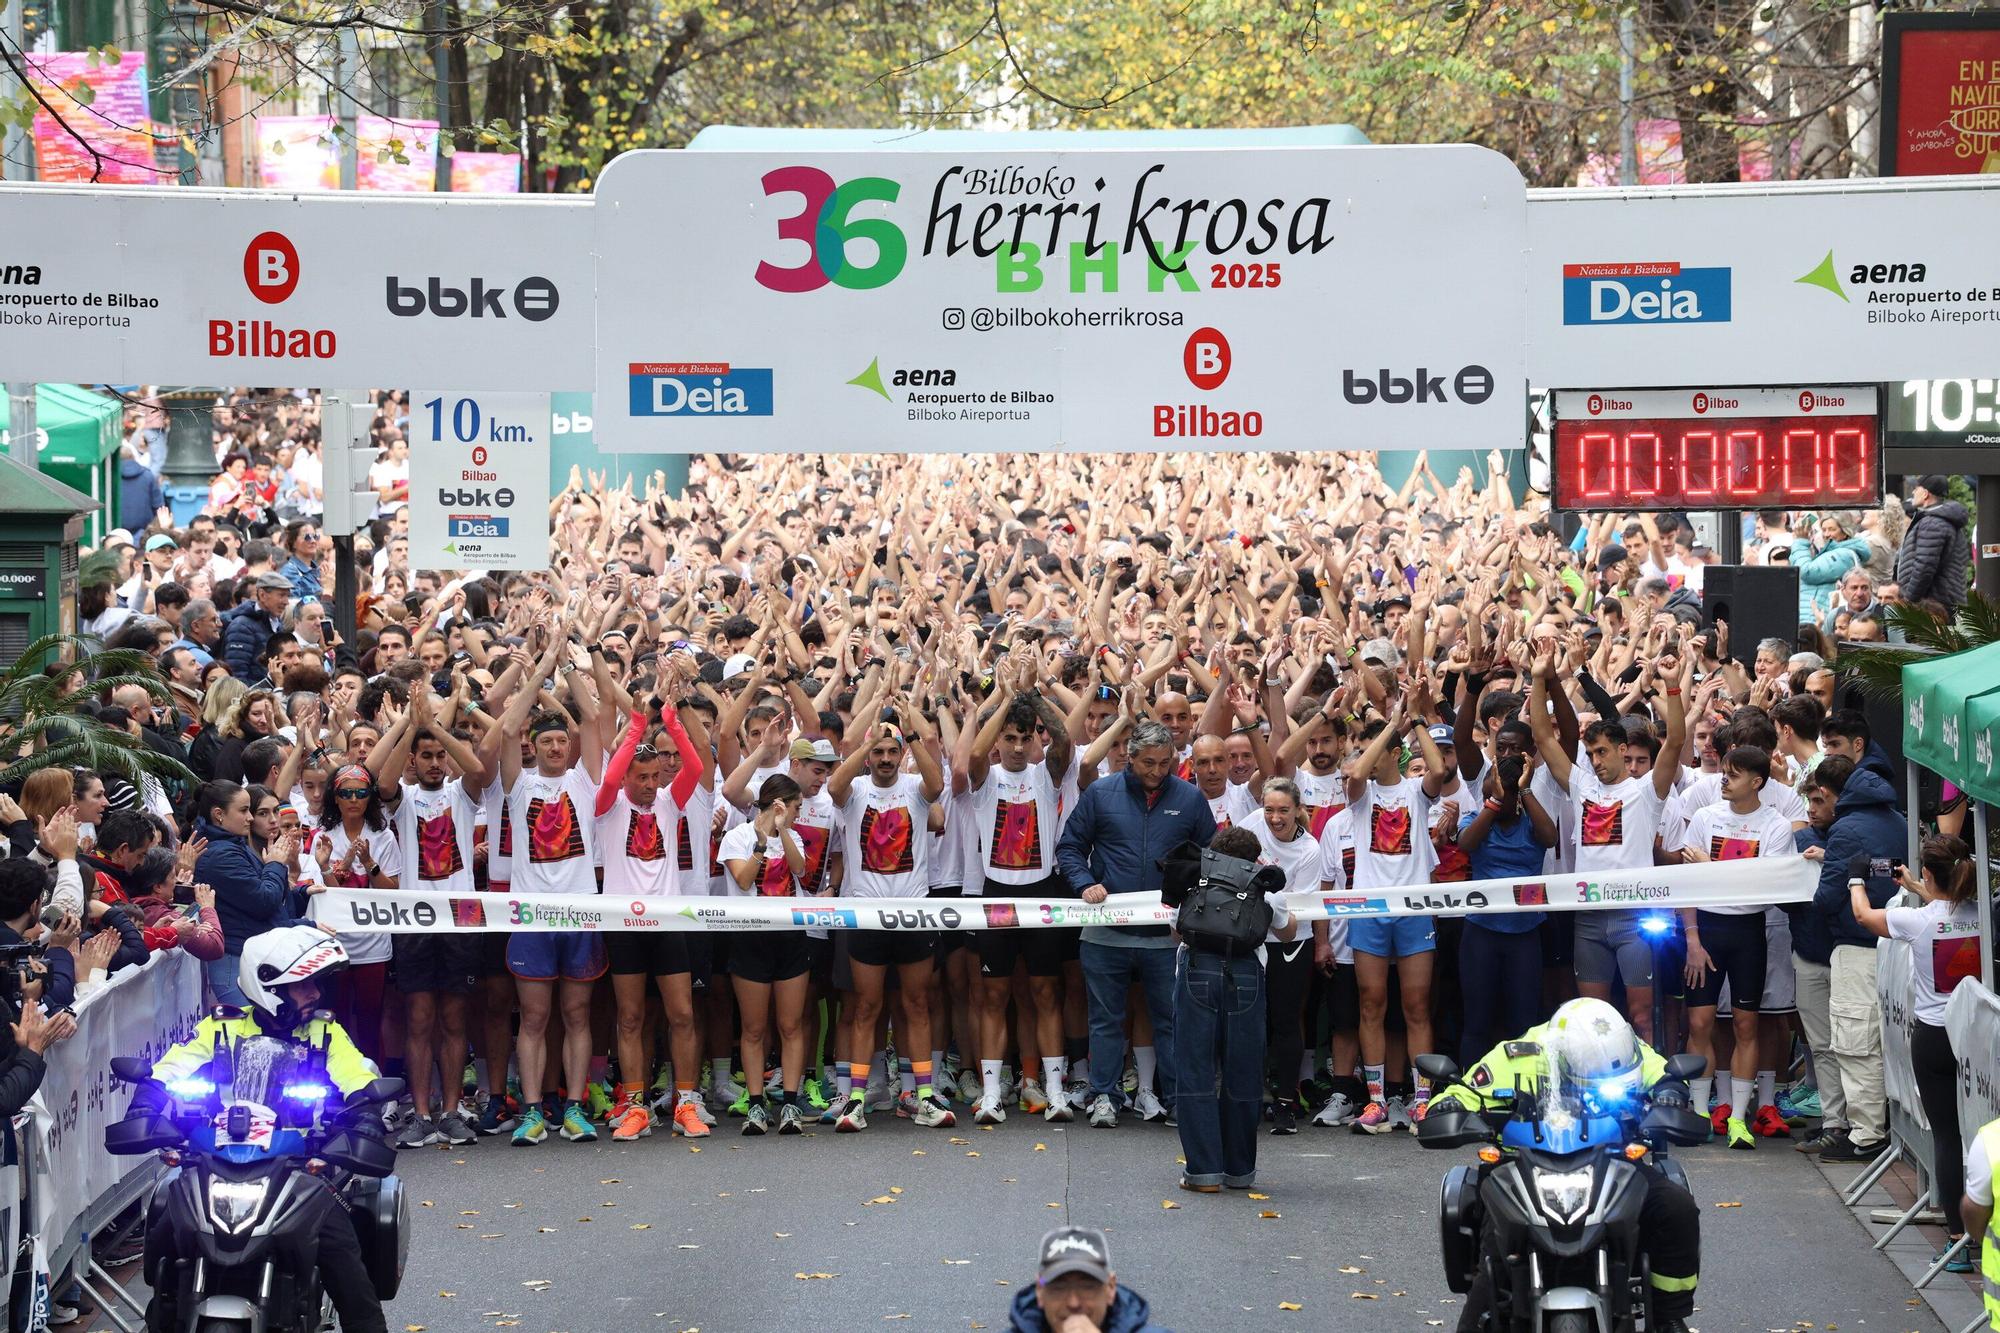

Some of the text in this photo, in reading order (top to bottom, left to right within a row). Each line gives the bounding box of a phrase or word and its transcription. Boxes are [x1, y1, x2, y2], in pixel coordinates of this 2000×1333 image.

[1959, 60, 1984, 82] EN
[1910, 136, 1956, 153] BOMBONES
[965, 166, 1076, 200] Bilboko
[754, 163, 1335, 293] 36 herri krosa
[0, 264, 42, 286] na
[257, 249, 289, 287] B
[1210, 262, 1281, 289] 2025
[1579, 264, 1673, 276] Noticias de Bizkaia
[1849, 262, 1927, 284] aena
[82, 292, 103, 307] de
[107, 292, 159, 309] Bilbao
[386, 276, 507, 318] bbk
[1590, 278, 1703, 321] Deia
[1867, 289, 1962, 306] Aeropuerto
[1966, 288, 1987, 302] de
[46, 311, 131, 330] Aireportua
[971, 306, 1184, 329] @bilbokoherrikrosa
[1867, 309, 1926, 324] Bilboko
[208, 319, 337, 359] Bilbao
[643, 364, 723, 374] Noticias de Bizkaia
[1196, 343, 1222, 375] B
[892, 369, 956, 387] aena
[1343, 368, 1448, 405] bbk
[652, 377, 749, 413] Deia
[907, 391, 1055, 406] Aeropuerto de Bilbao
[1588, 394, 1633, 415] Bilbao
[1693, 392, 1739, 413] Bilbao
[1799, 391, 1845, 411] Bilbao
[1903, 379, 2000, 432] 10:
[424, 396, 533, 443] 10 km.
[907, 408, 1031, 423] Bilboko Aireportua
[1153, 405, 1263, 437] Bilbao
[1579, 429, 1866, 496] 00:00:00
[462, 470, 497, 481] Bilbao
[438, 488, 491, 507] bbk
[458, 520, 499, 536] Deia
[1576, 881, 1601, 902] 36
[350, 901, 412, 926] bbk
[508, 900, 533, 925] 36
[623, 917, 659, 927] Bilbao
[697, 908, 726, 917] aena
[802, 911, 847, 928] Deia
[878, 910, 936, 929] bbk
[1039, 904, 1064, 924] 36
[33, 1284, 50, 1331] Deia
